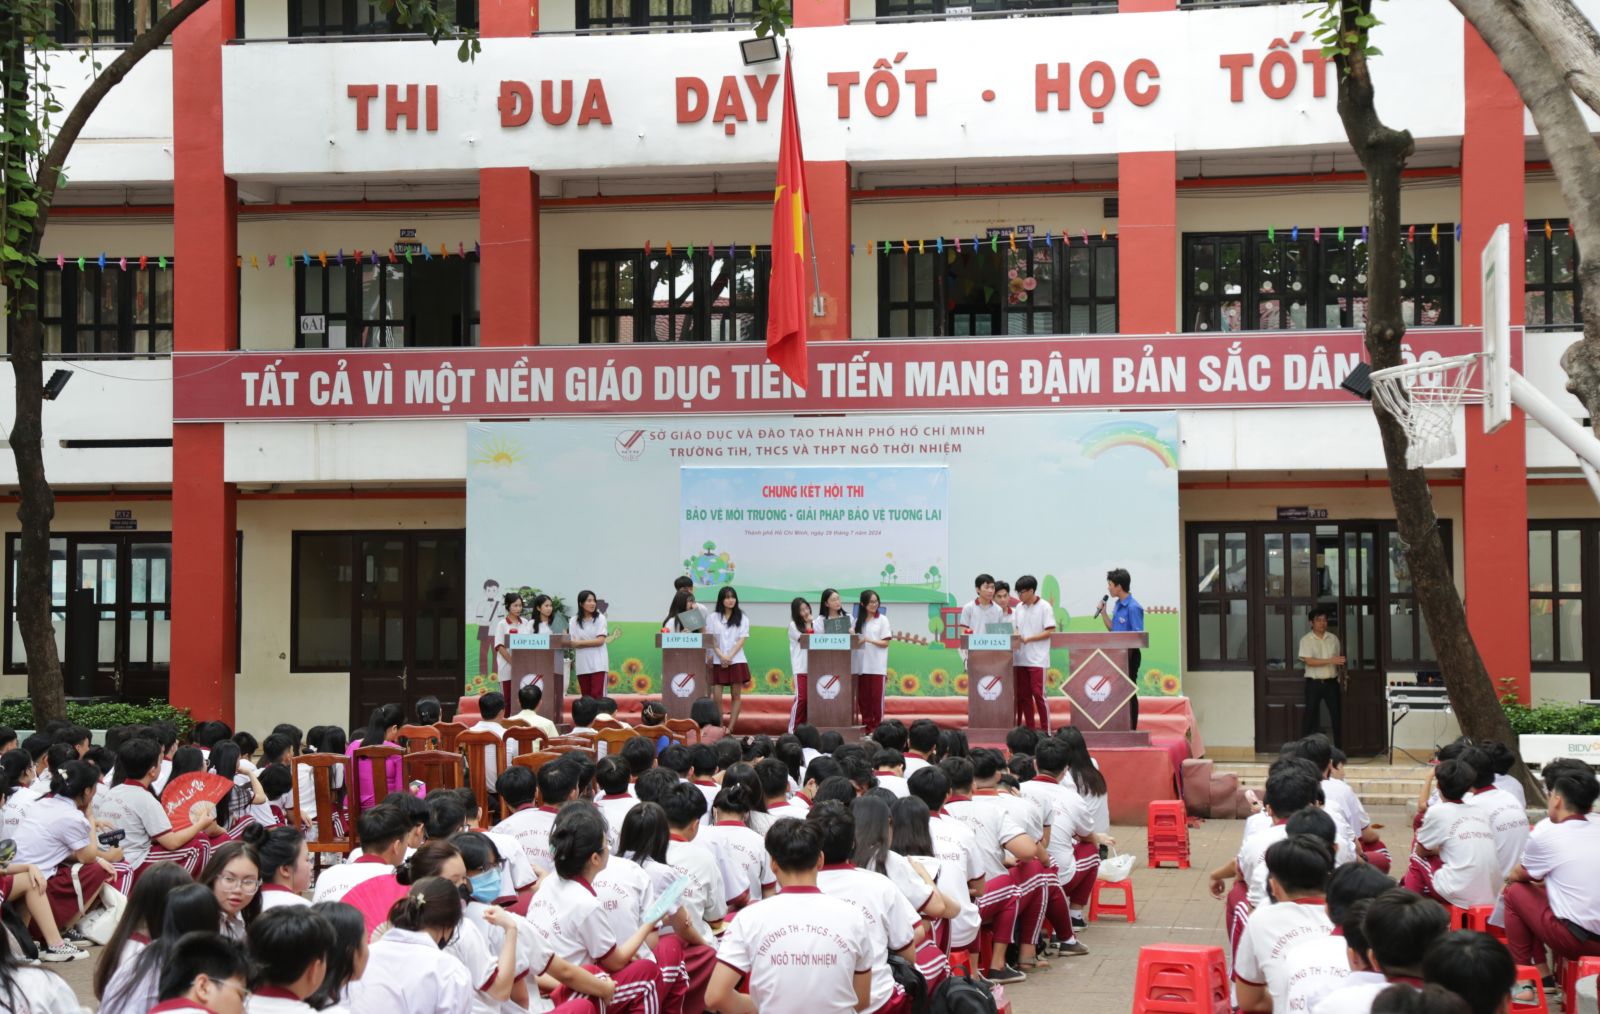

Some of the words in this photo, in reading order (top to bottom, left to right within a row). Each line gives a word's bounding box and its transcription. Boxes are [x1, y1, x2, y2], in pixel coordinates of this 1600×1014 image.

[347, 84, 438, 131] THI
[498, 79, 613, 128] ĐUA
[676, 74, 780, 136] DẠY
[827, 52, 937, 119] TỐT
[1035, 58, 1160, 124] HỌC
[1219, 31, 1335, 103] TỐT
[302, 317, 323, 331] 6A1
[241, 359, 299, 406] TẤT
[309, 359, 353, 406] CẢ
[363, 363, 393, 405] VÌ
[405, 361, 476, 411] MỘT
[486, 356, 554, 403] NỀN
[565, 359, 642, 402] GIÁO
[654, 365, 721, 408] DỤC
[817, 351, 892, 398] TIẾN
[905, 360, 1008, 397] MANG
[1020, 351, 1100, 402] ĐẬM
[1113, 344, 1186, 393] BẢN
[1199, 341, 1271, 392] SẮC
[650, 430, 666, 441] SỞ
[671, 429, 702, 440] GIÁO
[707, 430, 733, 442] DỤC
[738, 428, 753, 440] VÀ
[758, 427, 785, 439] ĐÀO
[790, 428, 814, 440] TẠO
[819, 425, 863, 437] THÀNH
[869, 424, 895, 437] PHỐ
[900, 424, 918, 437] HỒ
[924, 424, 945, 436] CHÍ
[950, 425, 985, 436] MINH
[670, 445, 723, 457] TRƯỜNG
[756, 446, 788, 456] THCS
[793, 444, 809, 455] VÀ
[814, 445, 846, 454] THPT
[851, 442, 879, 454] NGÔ
[883, 442, 914, 454] THỜI
[919, 441, 962, 456] NHIỆM
[762, 485, 797, 498] CHUNG
[800, 482, 821, 498] KẾT
[824, 482, 843, 500] HỘI
[846, 485, 864, 498] THI
[686, 506, 707, 520] BẢO
[710, 506, 722, 523] VỆ
[725, 506, 744, 520] MÔI
[747, 506, 787, 520] TRƯỜNG
[796, 506, 816, 520] GIẢI
[820, 506, 845, 520] PHÁP
[847, 506, 869, 520] BẢO
[872, 506, 885, 523] VỆ
[888, 508, 923, 520] TƯƠNG
[925, 509, 941, 520] LAI
[1568, 743, 1592, 752] BIDV
[593, 880, 607, 888] HCS
[861, 905, 876, 925] THPT
[1299, 926, 1313, 934] TH
[757, 925, 787, 957] TRƯỜNG
[788, 924, 799, 934] TH
[806, 924, 829, 937] THCS
[833, 934, 851, 954] THPT
[770, 951, 789, 966] NGÔ
[791, 951, 811, 966] THỜI
[811, 953, 838, 969] NHIỆM
